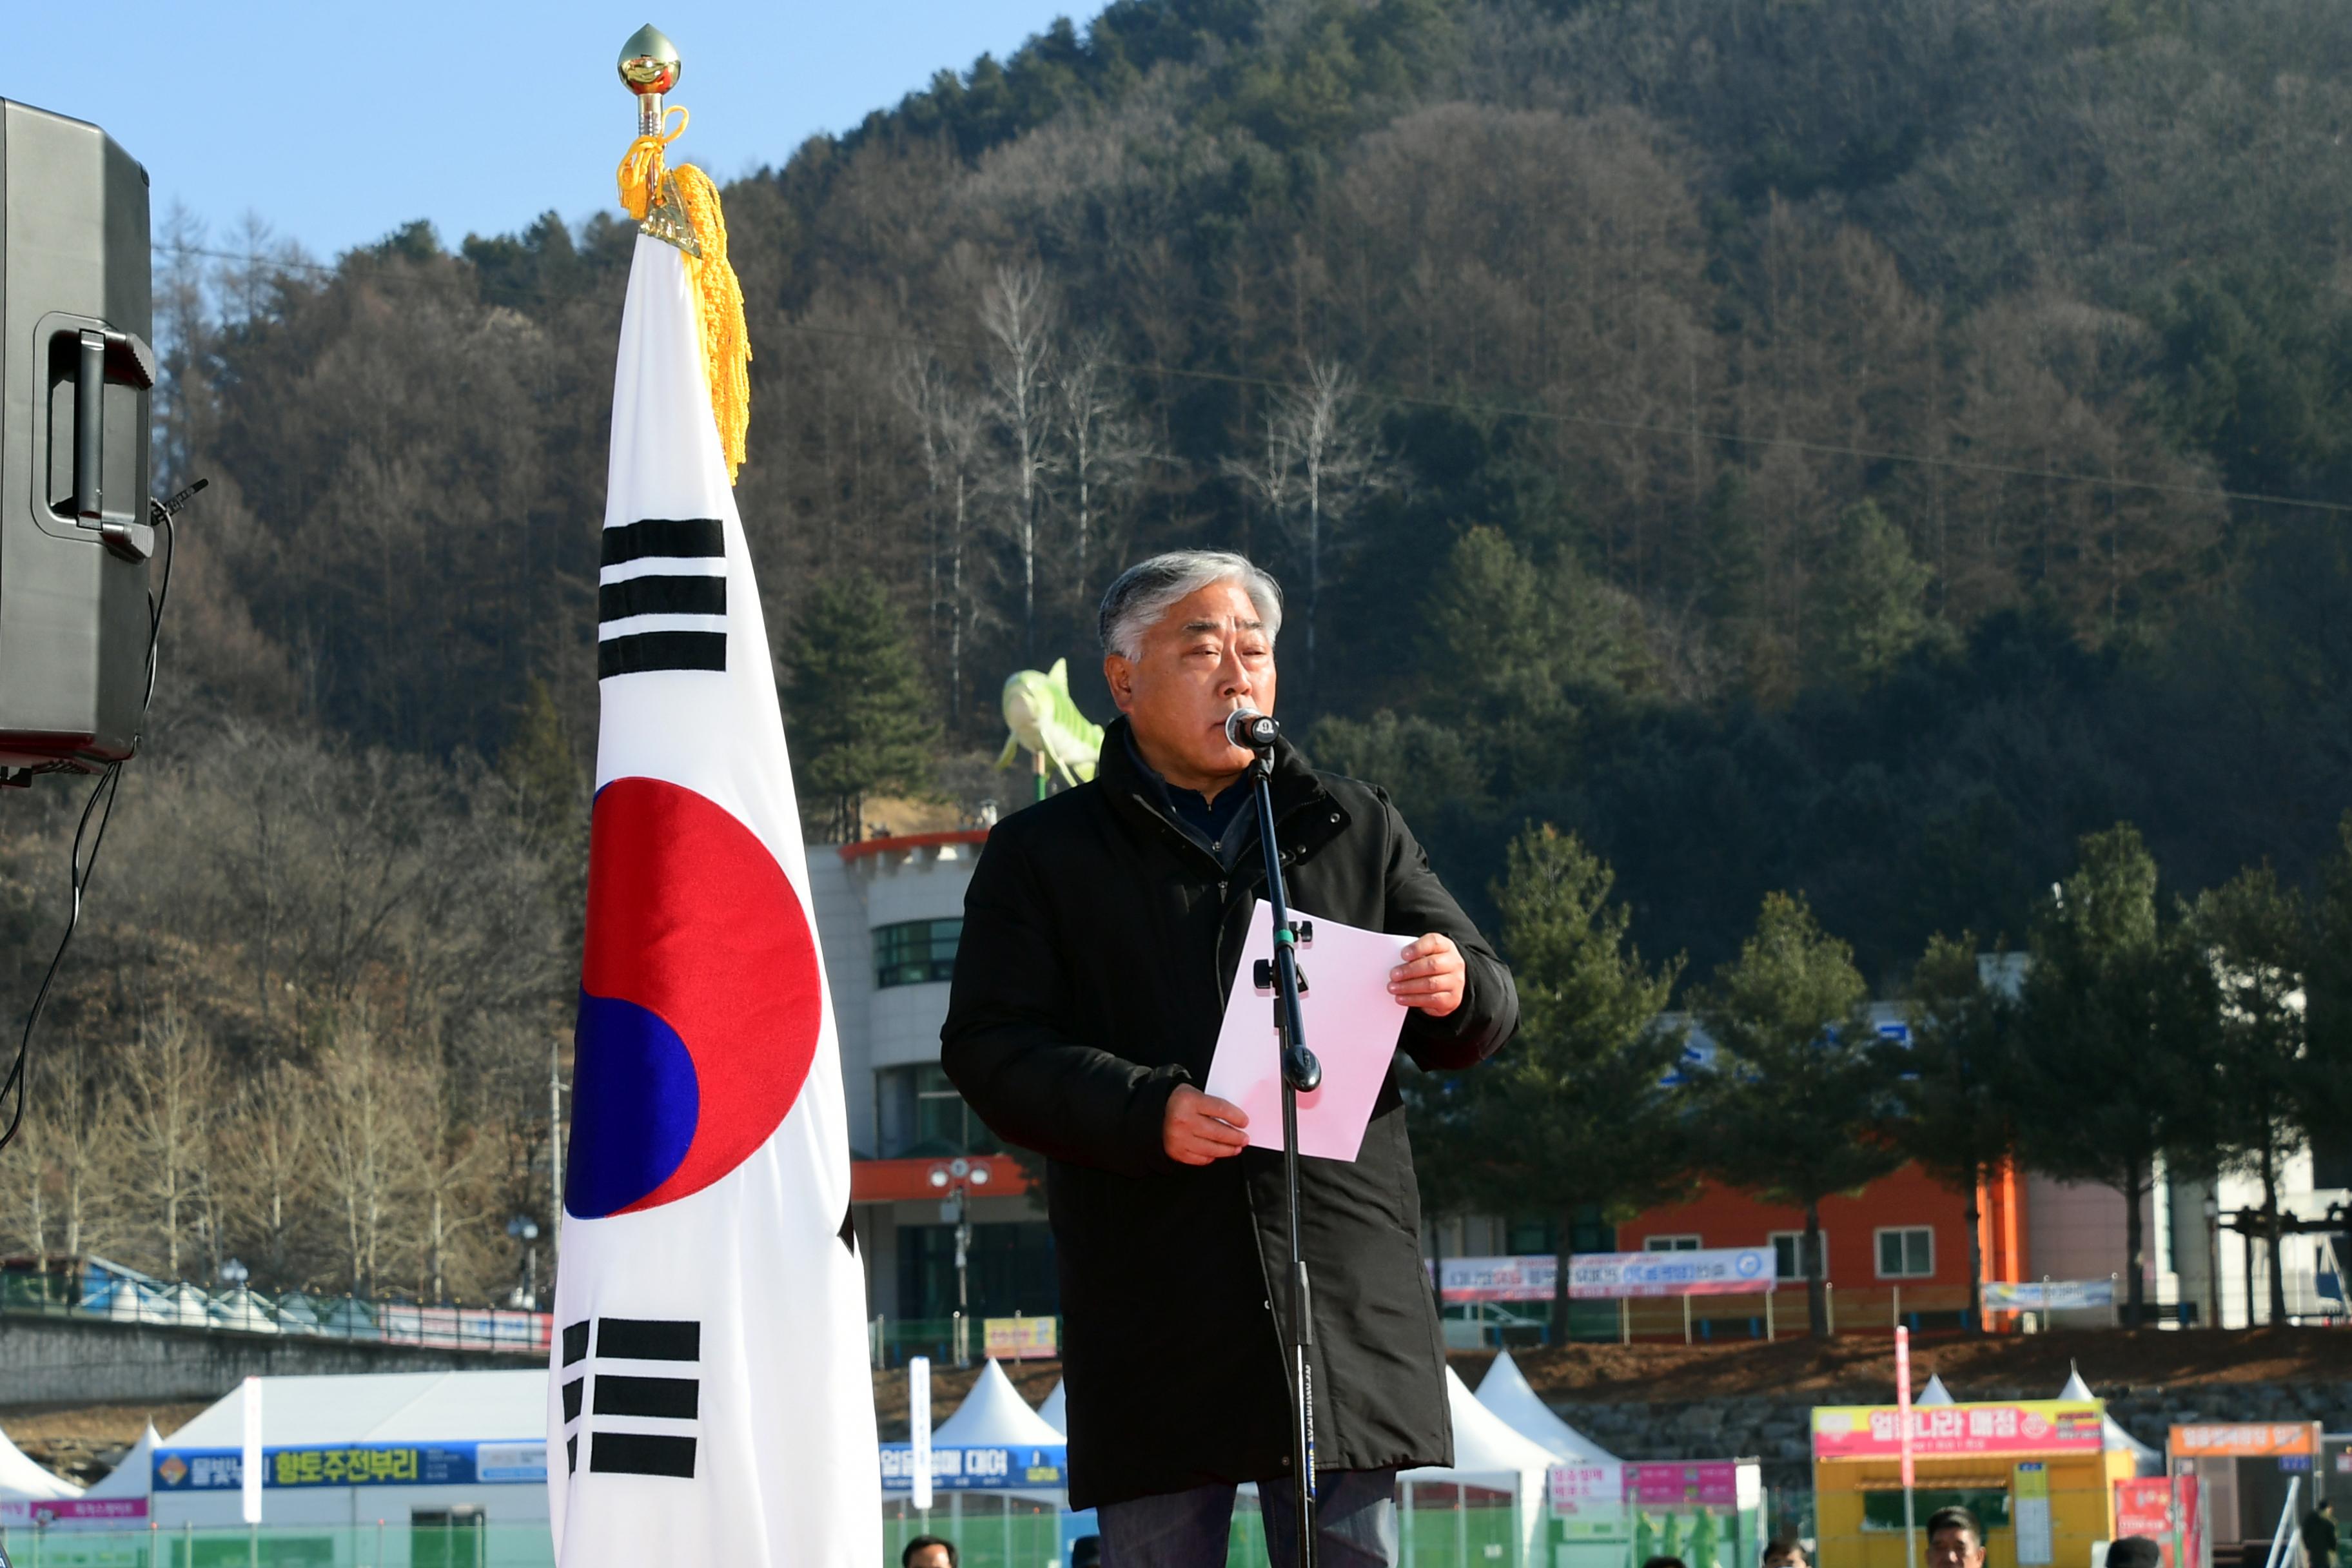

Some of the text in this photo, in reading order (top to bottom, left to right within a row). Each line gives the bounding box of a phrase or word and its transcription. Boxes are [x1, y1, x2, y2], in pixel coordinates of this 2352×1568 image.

[1262, 721, 1269, 731] 9
[1969, 1408, 2017, 1438] 매점
[275, 1448, 418, 1484] 향토주전부리
[965, 1448, 1008, 1476] 대여
